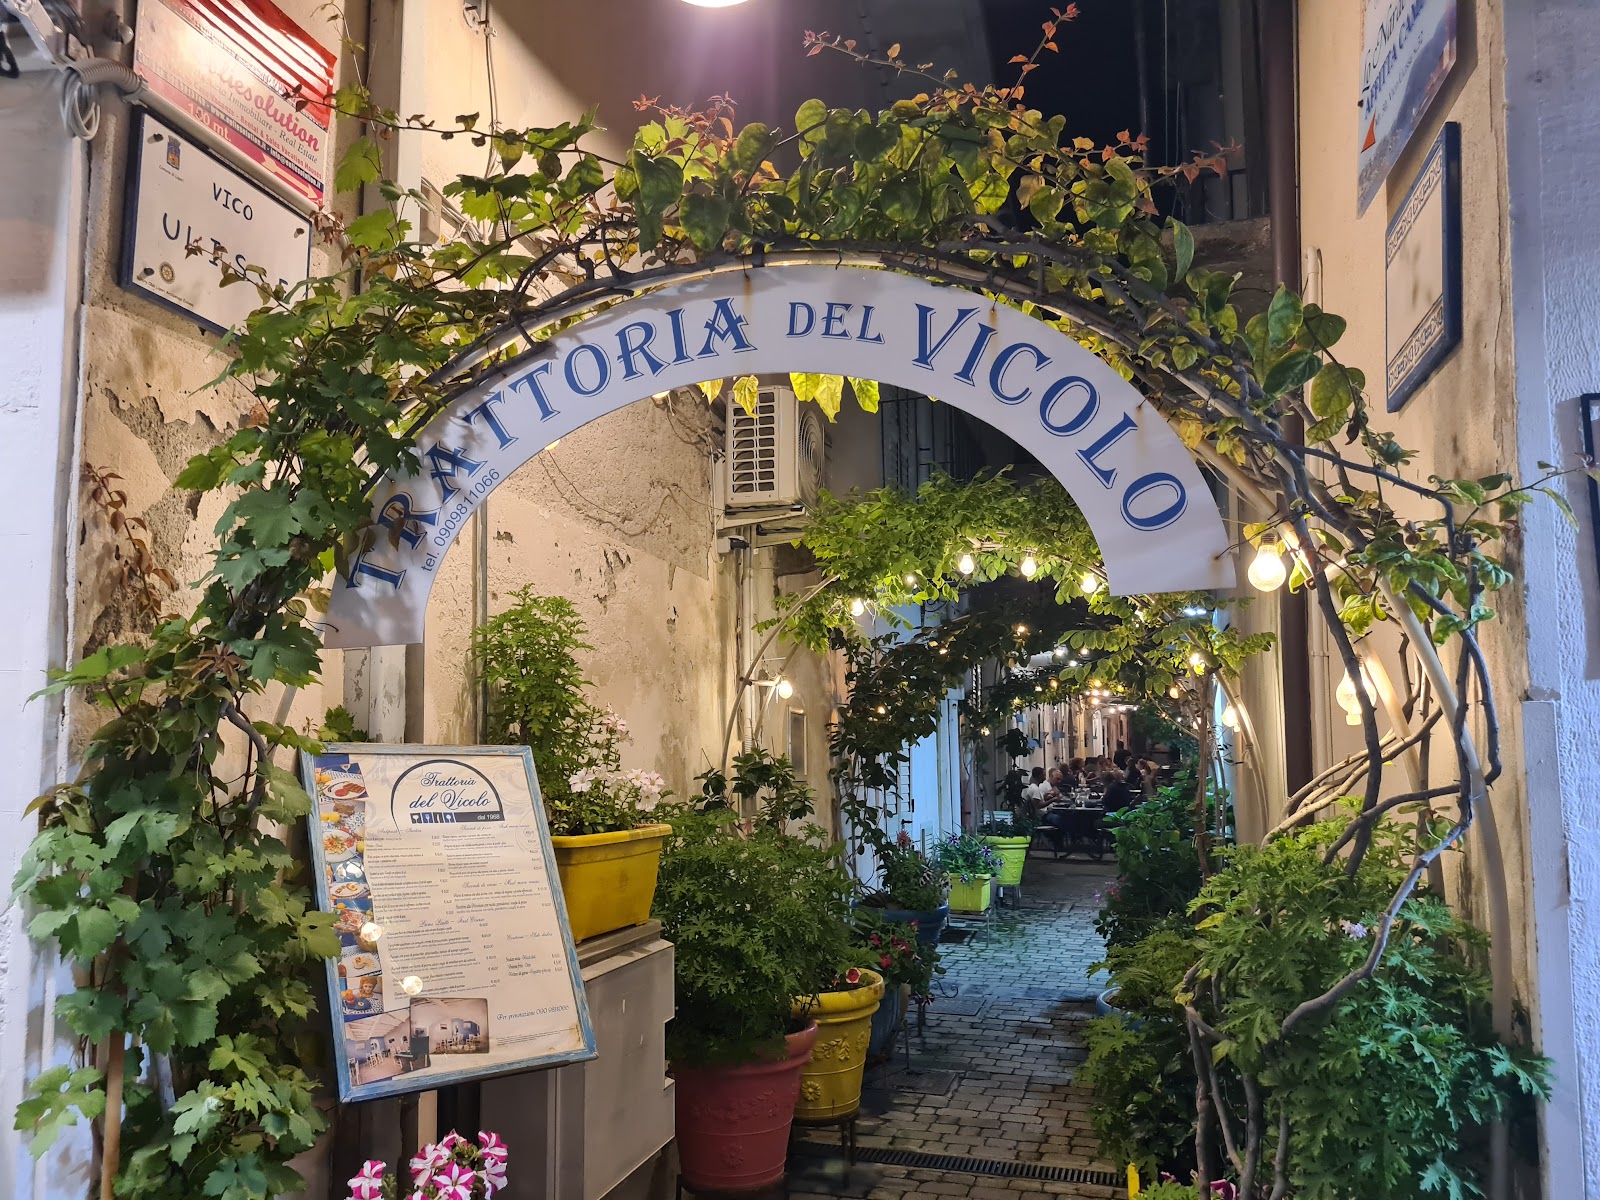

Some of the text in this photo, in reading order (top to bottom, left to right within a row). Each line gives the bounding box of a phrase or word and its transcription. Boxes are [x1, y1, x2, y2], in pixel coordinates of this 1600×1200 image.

[228, 90, 318, 164] Immobiliare Real Estate
[212, 182, 254, 221] VICO
[162, 212, 290, 298] ULIS
[345, 296, 1189, 590] TRATTORIA DEL VICOLO
[420, 467, 501, 573] tel. 0909811066
[409, 788, 491, 811] del Vicolo
[421, 771, 477, 787] Trattoria
